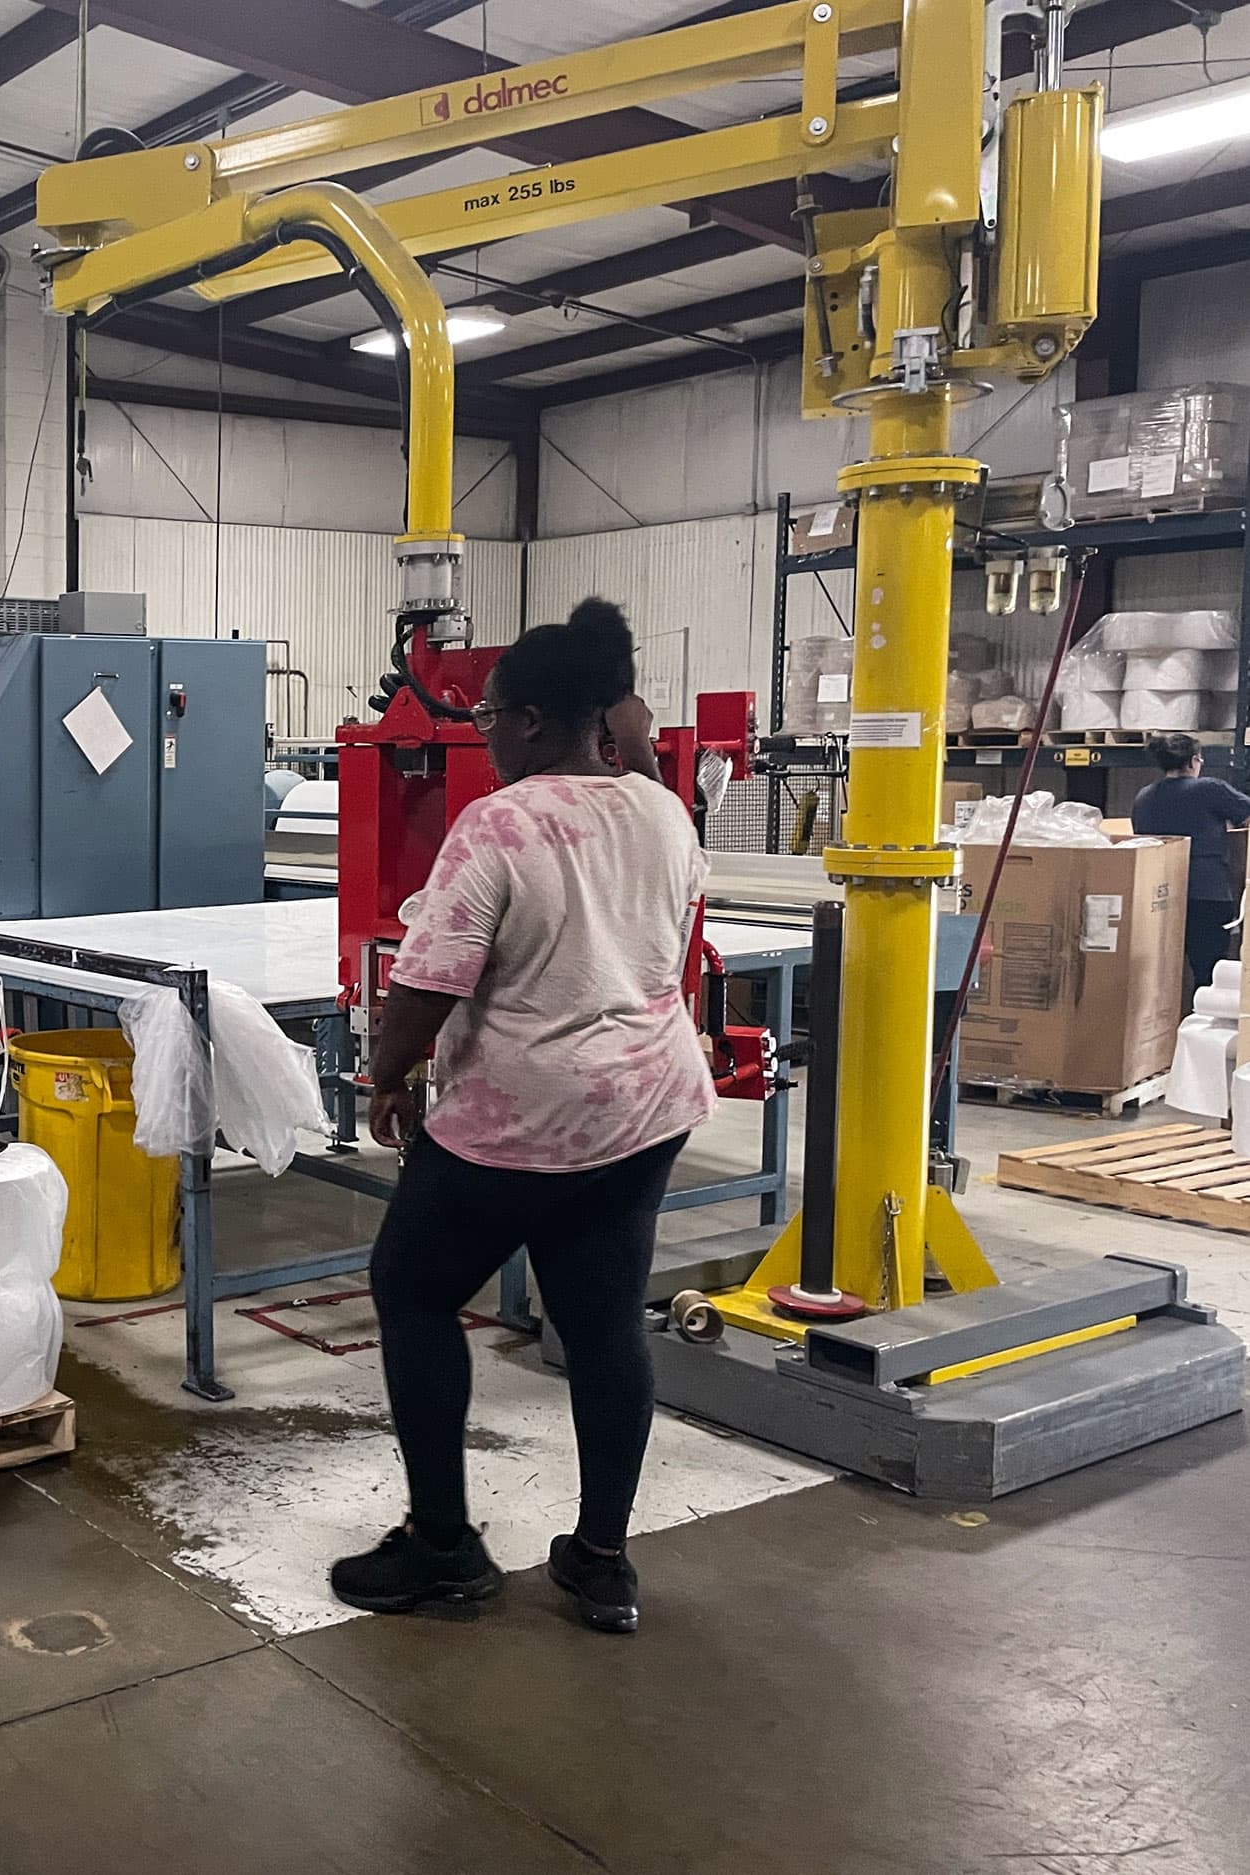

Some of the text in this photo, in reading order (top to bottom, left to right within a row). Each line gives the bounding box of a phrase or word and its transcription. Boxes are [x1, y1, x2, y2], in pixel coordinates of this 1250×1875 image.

[464, 75, 568, 114] dalmec
[464, 178, 576, 212] max 255 lbs
